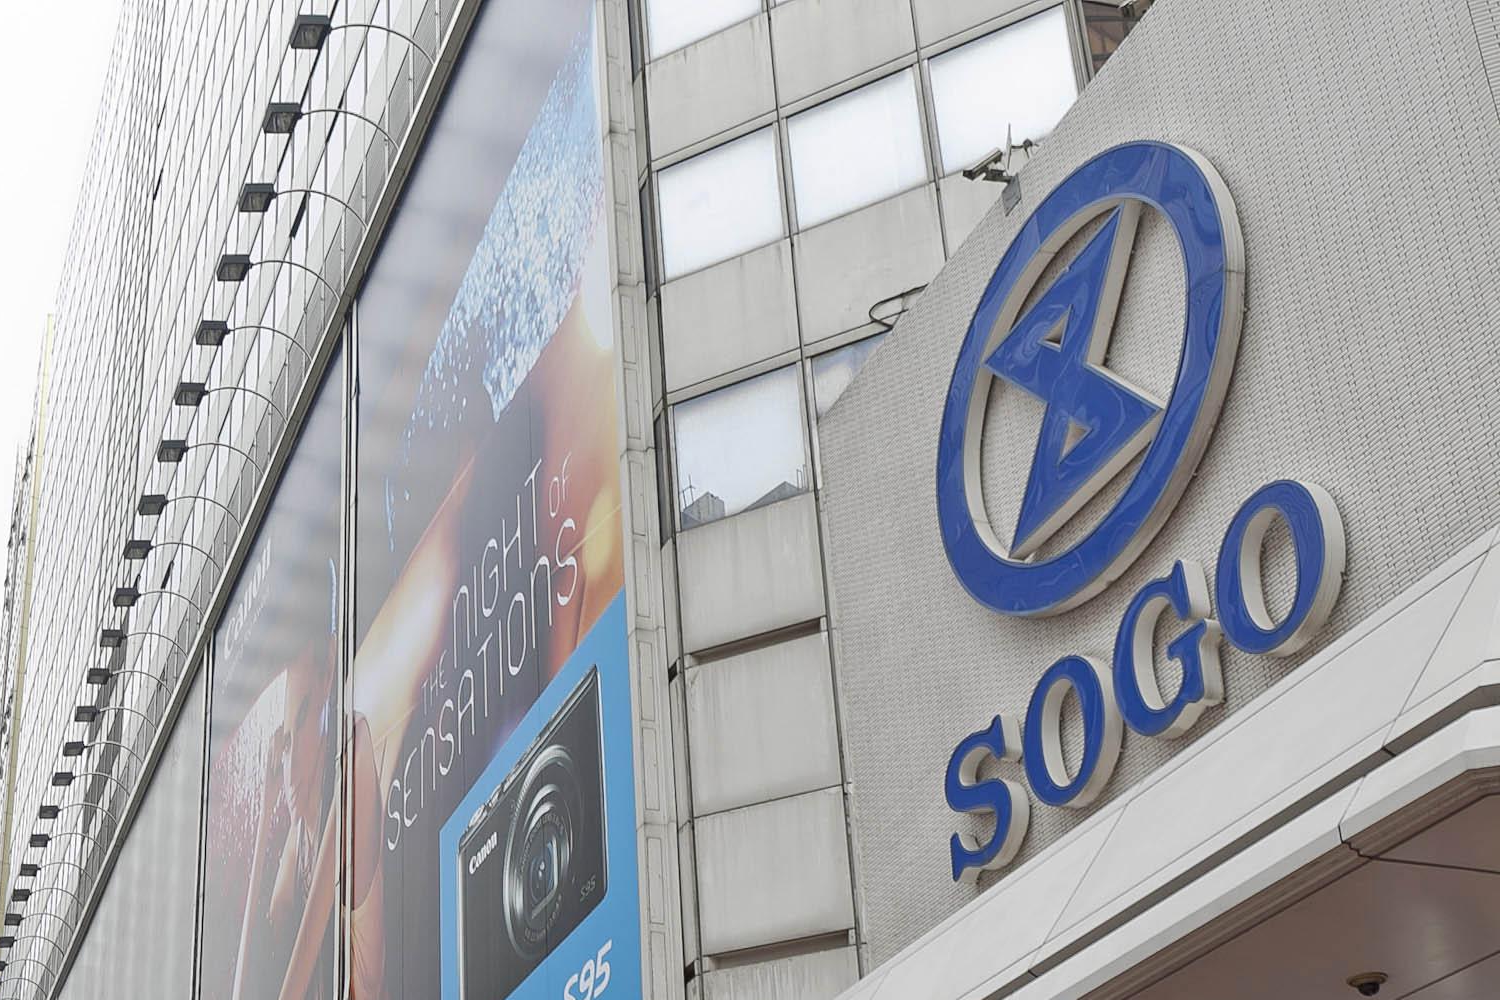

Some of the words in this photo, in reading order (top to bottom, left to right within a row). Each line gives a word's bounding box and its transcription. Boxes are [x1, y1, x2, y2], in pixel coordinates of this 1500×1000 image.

[387, 517, 578, 851] SENSATIONS
[421, 649, 448, 715] THE
[548, 451, 572, 520] OF
[945, 478, 1347, 884] SOGO
[468, 831, 497, 875] Canon
